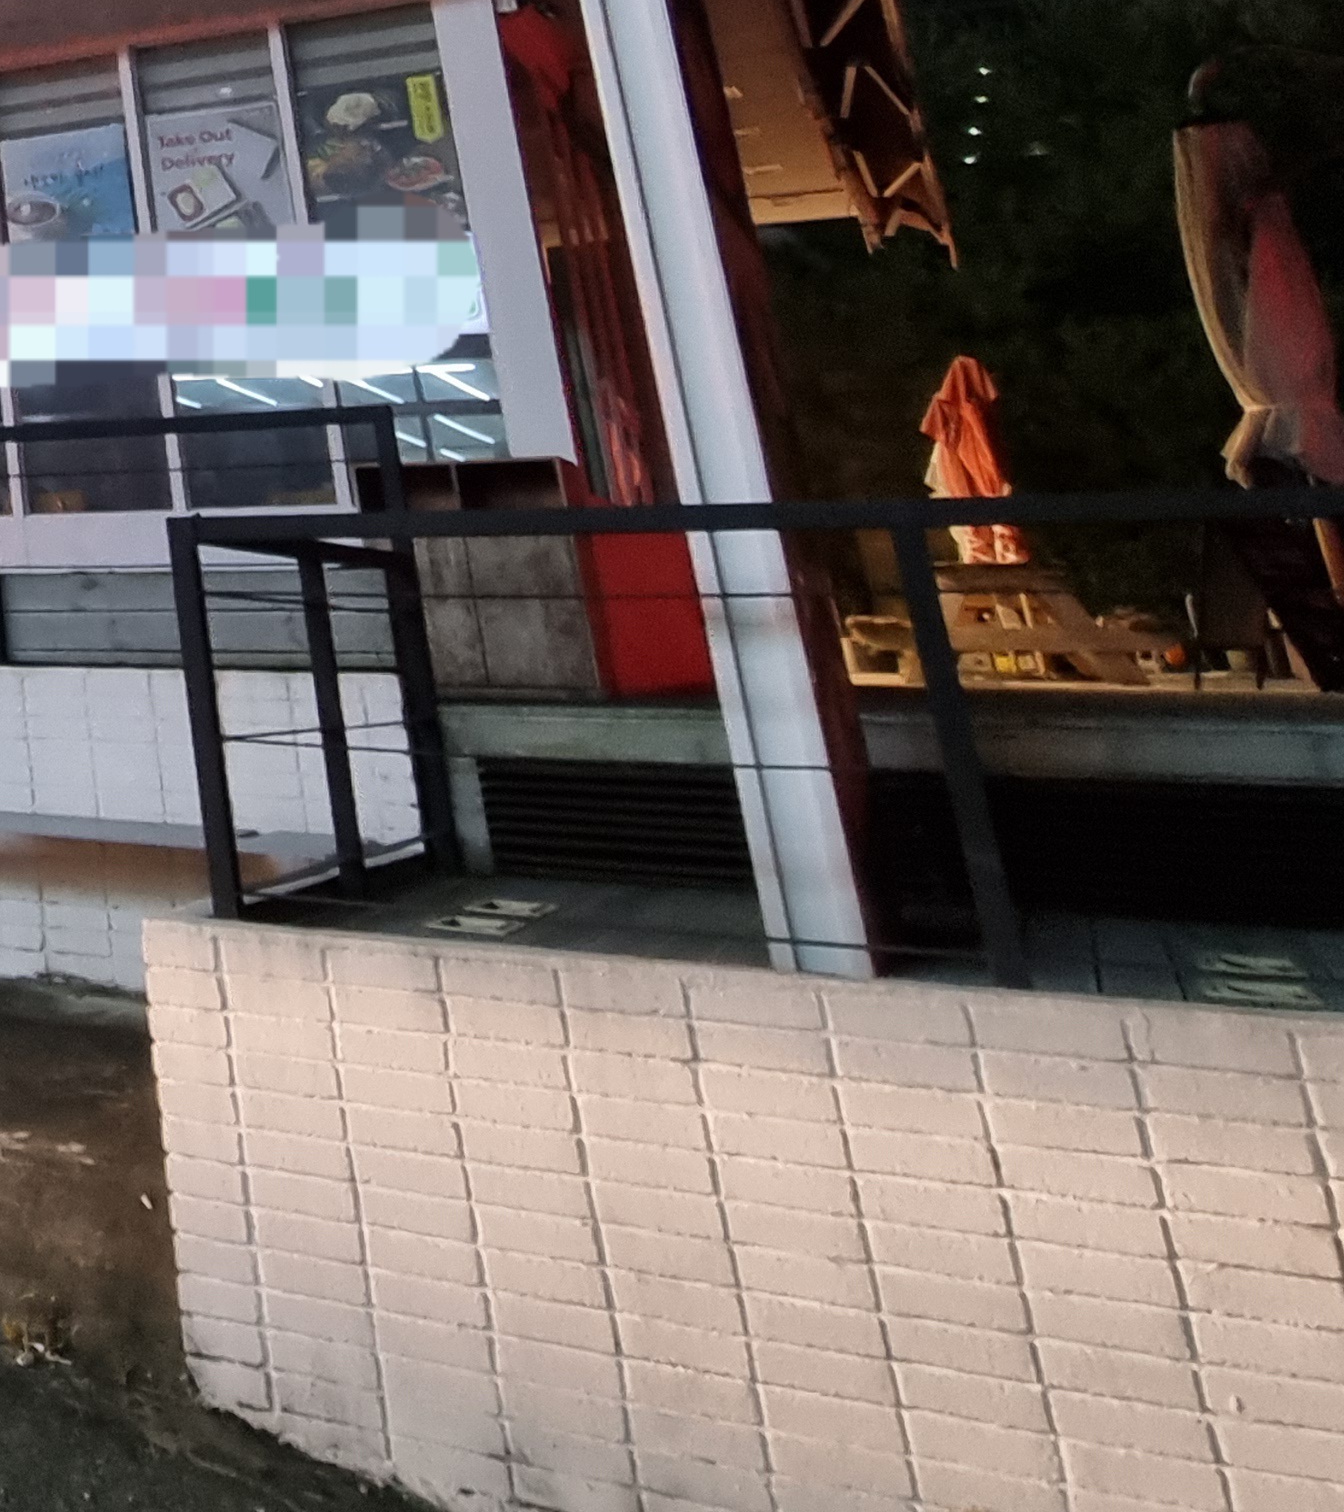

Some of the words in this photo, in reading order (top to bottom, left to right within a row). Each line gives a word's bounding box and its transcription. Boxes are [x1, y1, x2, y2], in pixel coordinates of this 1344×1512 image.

[158, 132, 196, 149] Take
[198, 128, 233, 144] Out
[161, 151, 235, 172] Delivery
